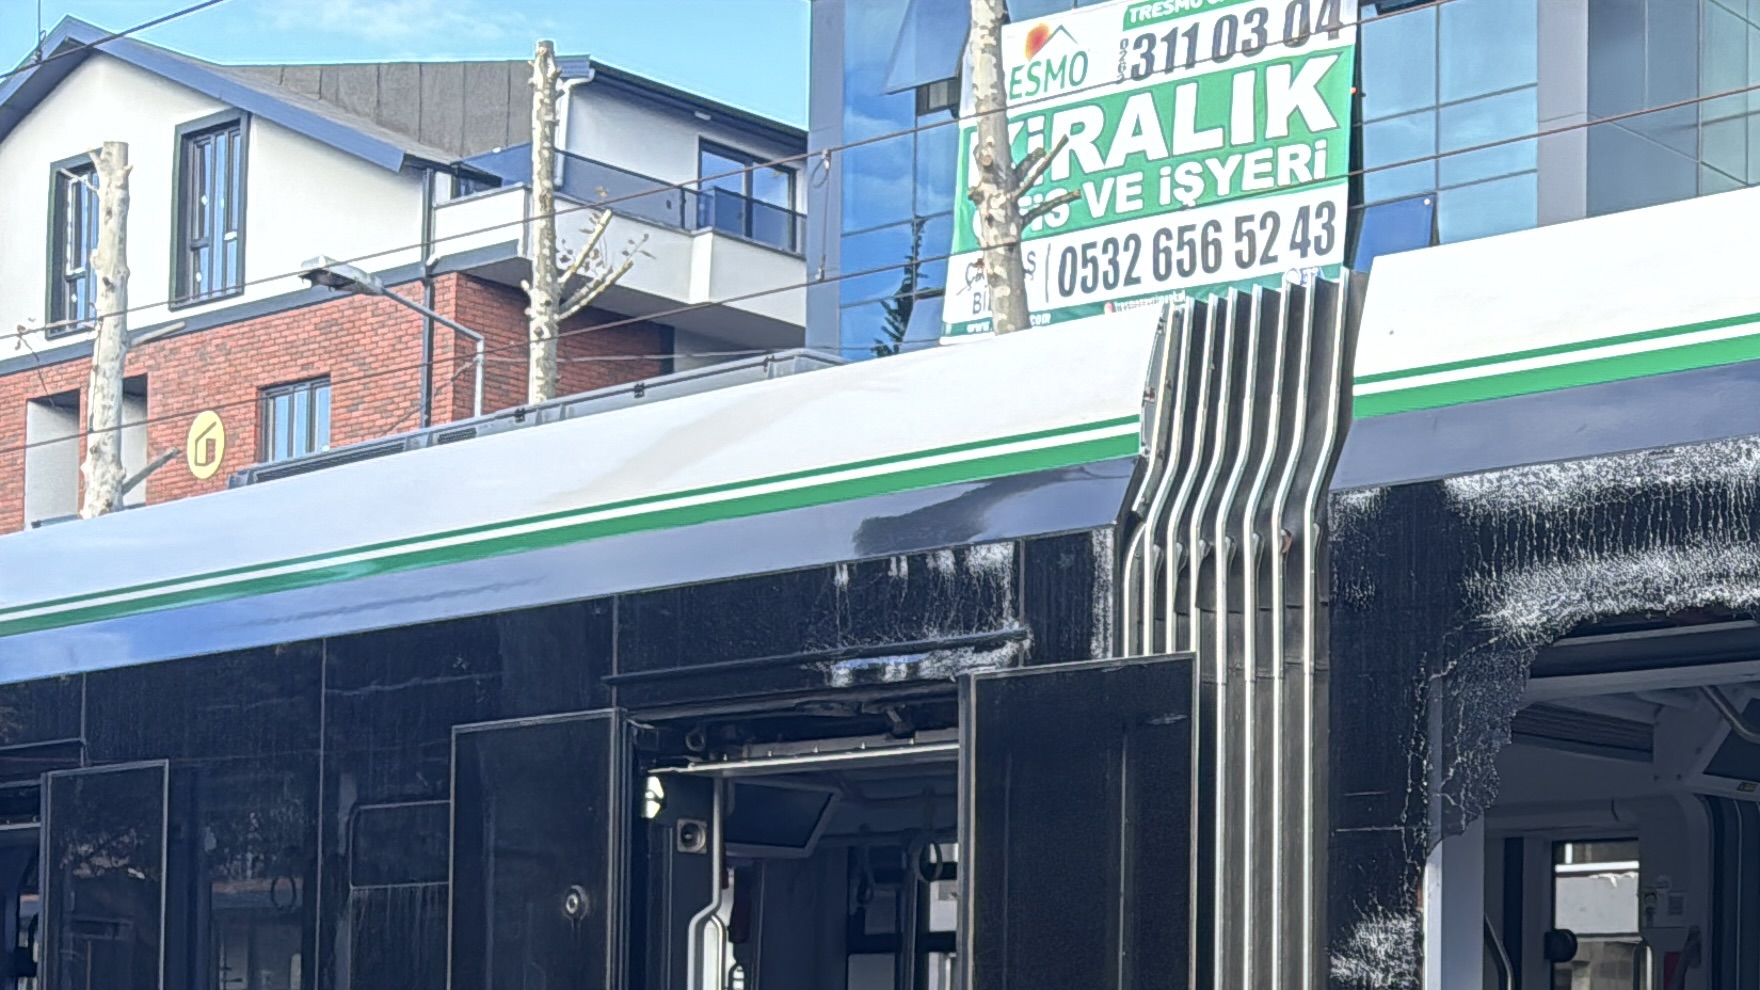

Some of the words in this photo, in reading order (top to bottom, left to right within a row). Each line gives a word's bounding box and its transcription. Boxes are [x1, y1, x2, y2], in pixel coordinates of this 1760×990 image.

[1131, 22, 1199, 81] 311
[1211, 6, 1269, 63] 03
[1283, 0, 1343, 47] 04
[1082, 171, 1143, 219] VE
[1058, 232, 1142, 298] 0532
[1152, 219, 1223, 282] 656
[1234, 210, 1281, 269] 52
[1289, 200, 1336, 259] 43
